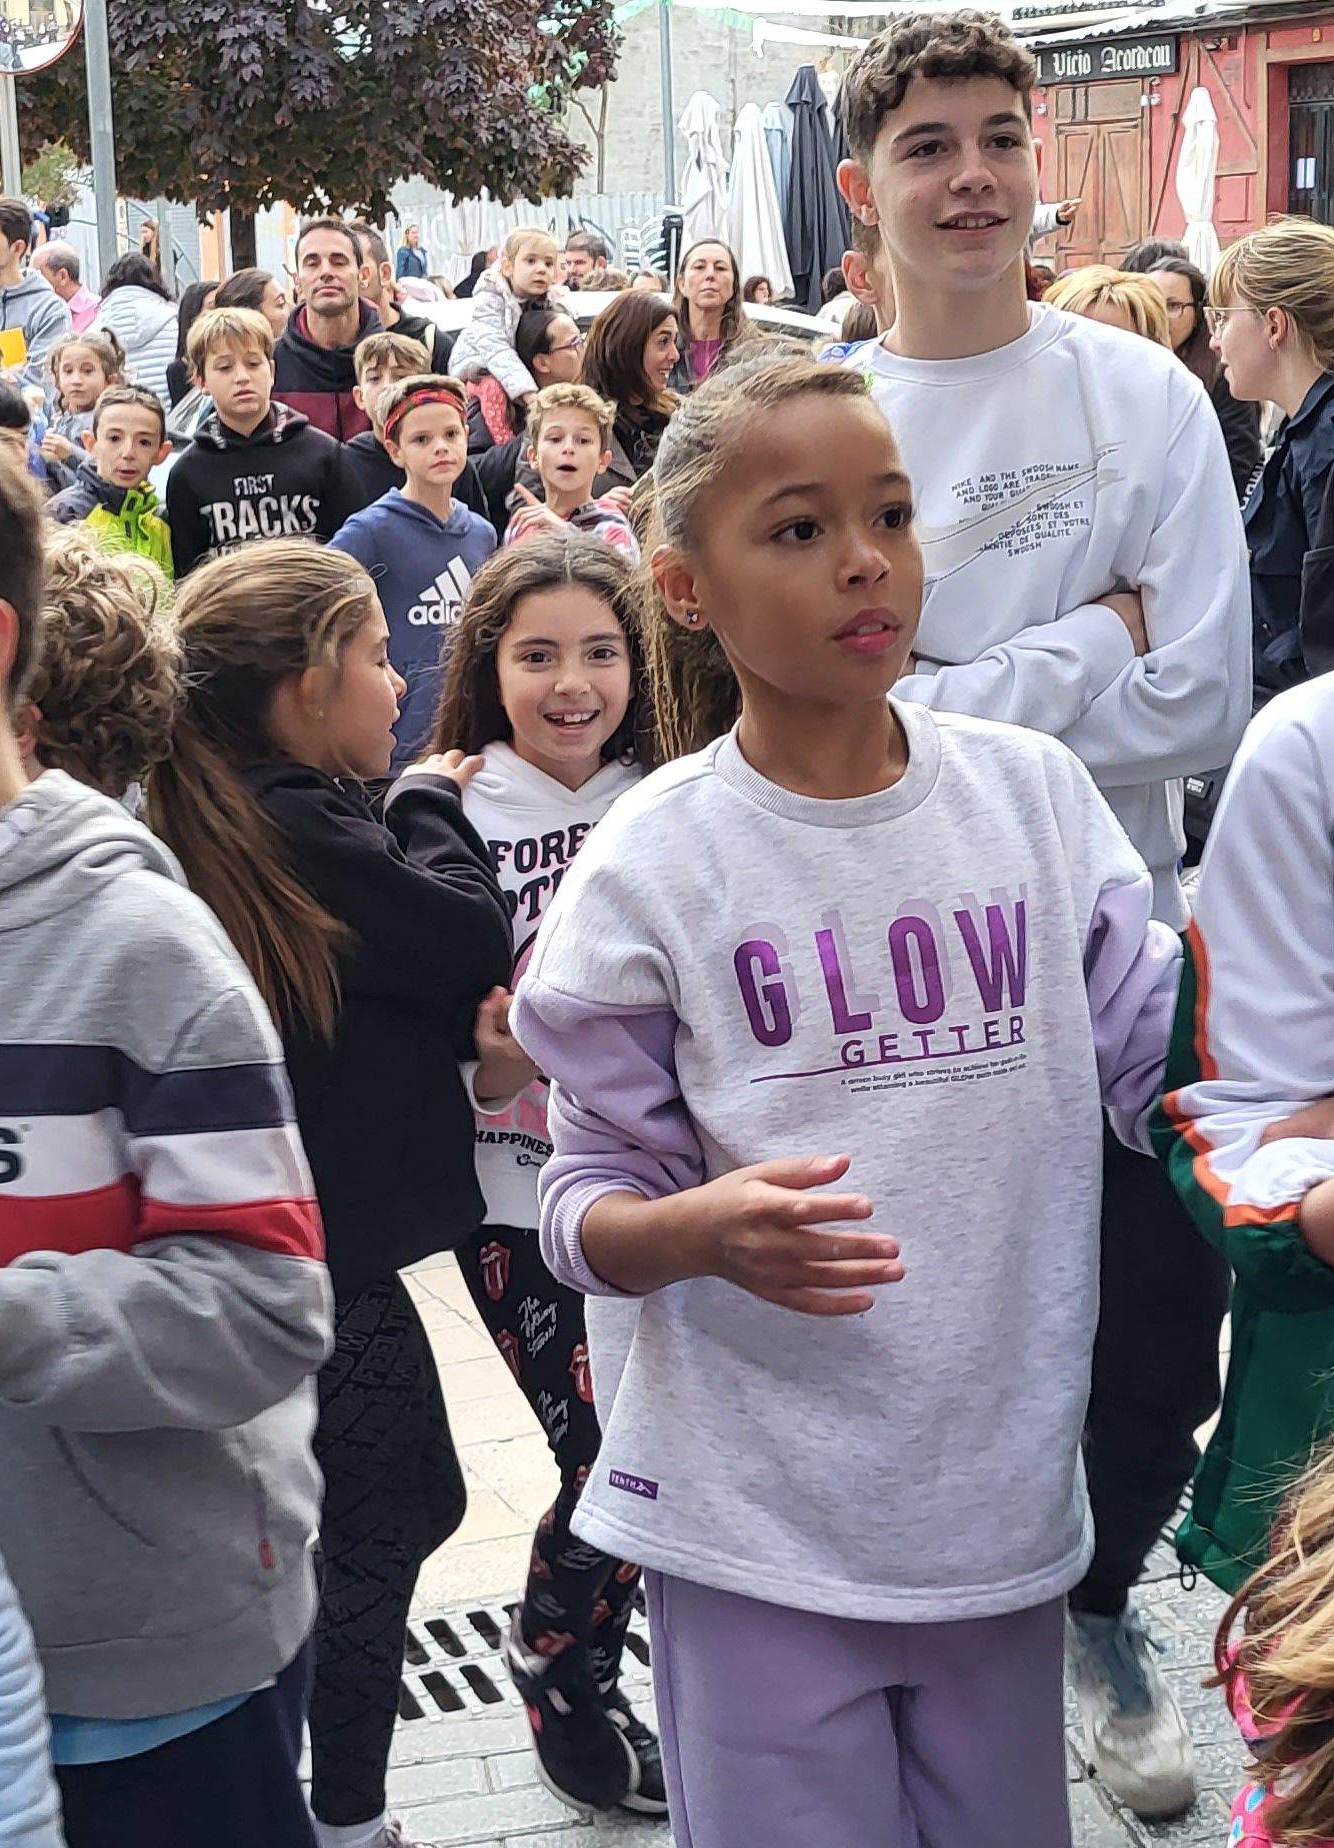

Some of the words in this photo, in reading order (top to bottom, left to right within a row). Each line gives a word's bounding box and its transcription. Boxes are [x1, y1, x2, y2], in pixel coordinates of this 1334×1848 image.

[979, 473, 996, 484] AND
[1000, 470, 1017, 481] THE
[1055, 462, 1081, 473] NAME
[233, 473, 275, 496] FIRST
[956, 487, 975, 499] AND
[979, 483, 999, 493] LOGO
[1003, 479, 1020, 489] ARE
[963, 494, 982, 505] AND
[984, 490, 1005, 501] YOUR
[1073, 500, 1084, 510] ET
[199, 494, 320, 543] TRACKS
[1047, 519, 1057, 529] ET
[1063, 518, 1091, 528] VOTRE
[1007, 541, 1042, 558] SWOOSH
[734, 894, 1027, 1047] GLOW
[841, 1015, 1026, 1067] GETTER
[475, 1130, 554, 1157] HAPPINES
